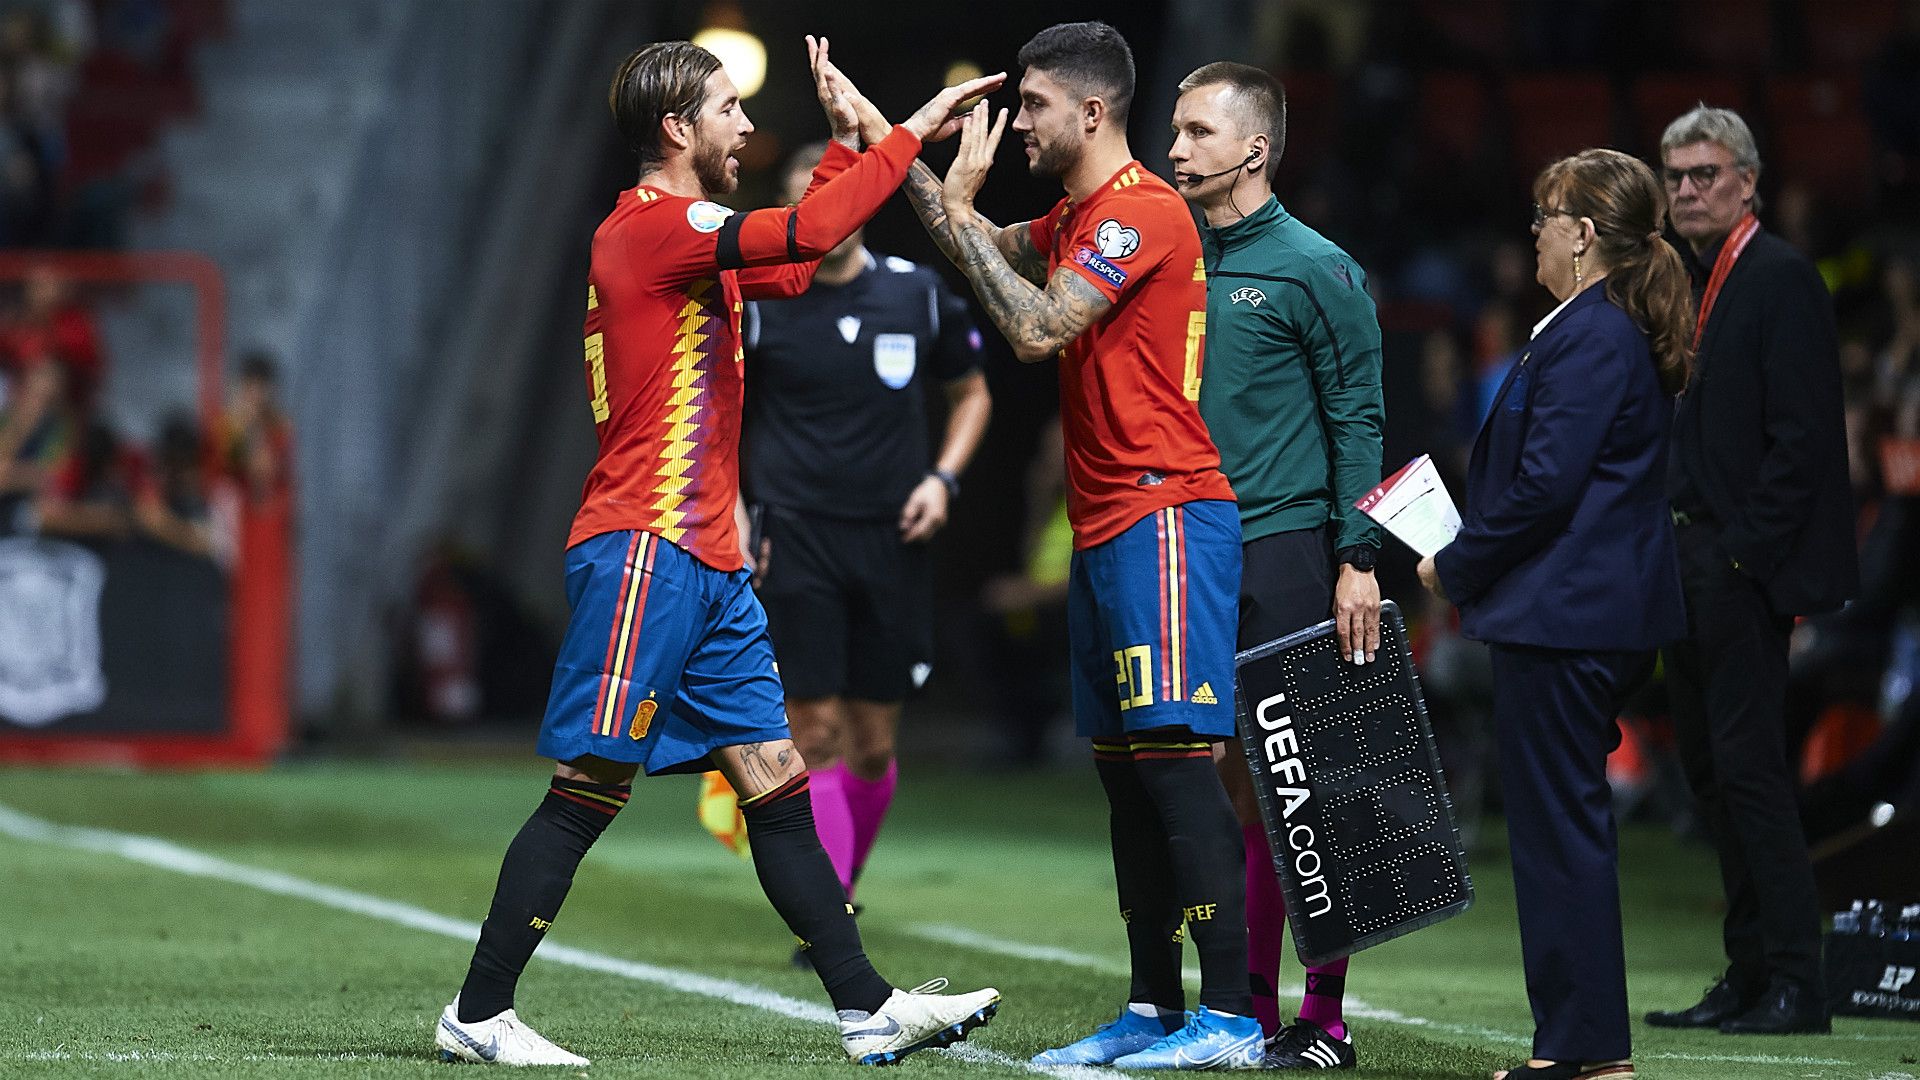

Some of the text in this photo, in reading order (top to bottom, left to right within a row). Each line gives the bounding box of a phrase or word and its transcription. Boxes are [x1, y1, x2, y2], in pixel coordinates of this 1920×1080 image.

[1088, 257, 1127, 284] RESPECT
[1229, 287, 1267, 308] UEFA
[1113, 644, 1154, 712] 20
[1256, 692, 1332, 919] UEFA.com
